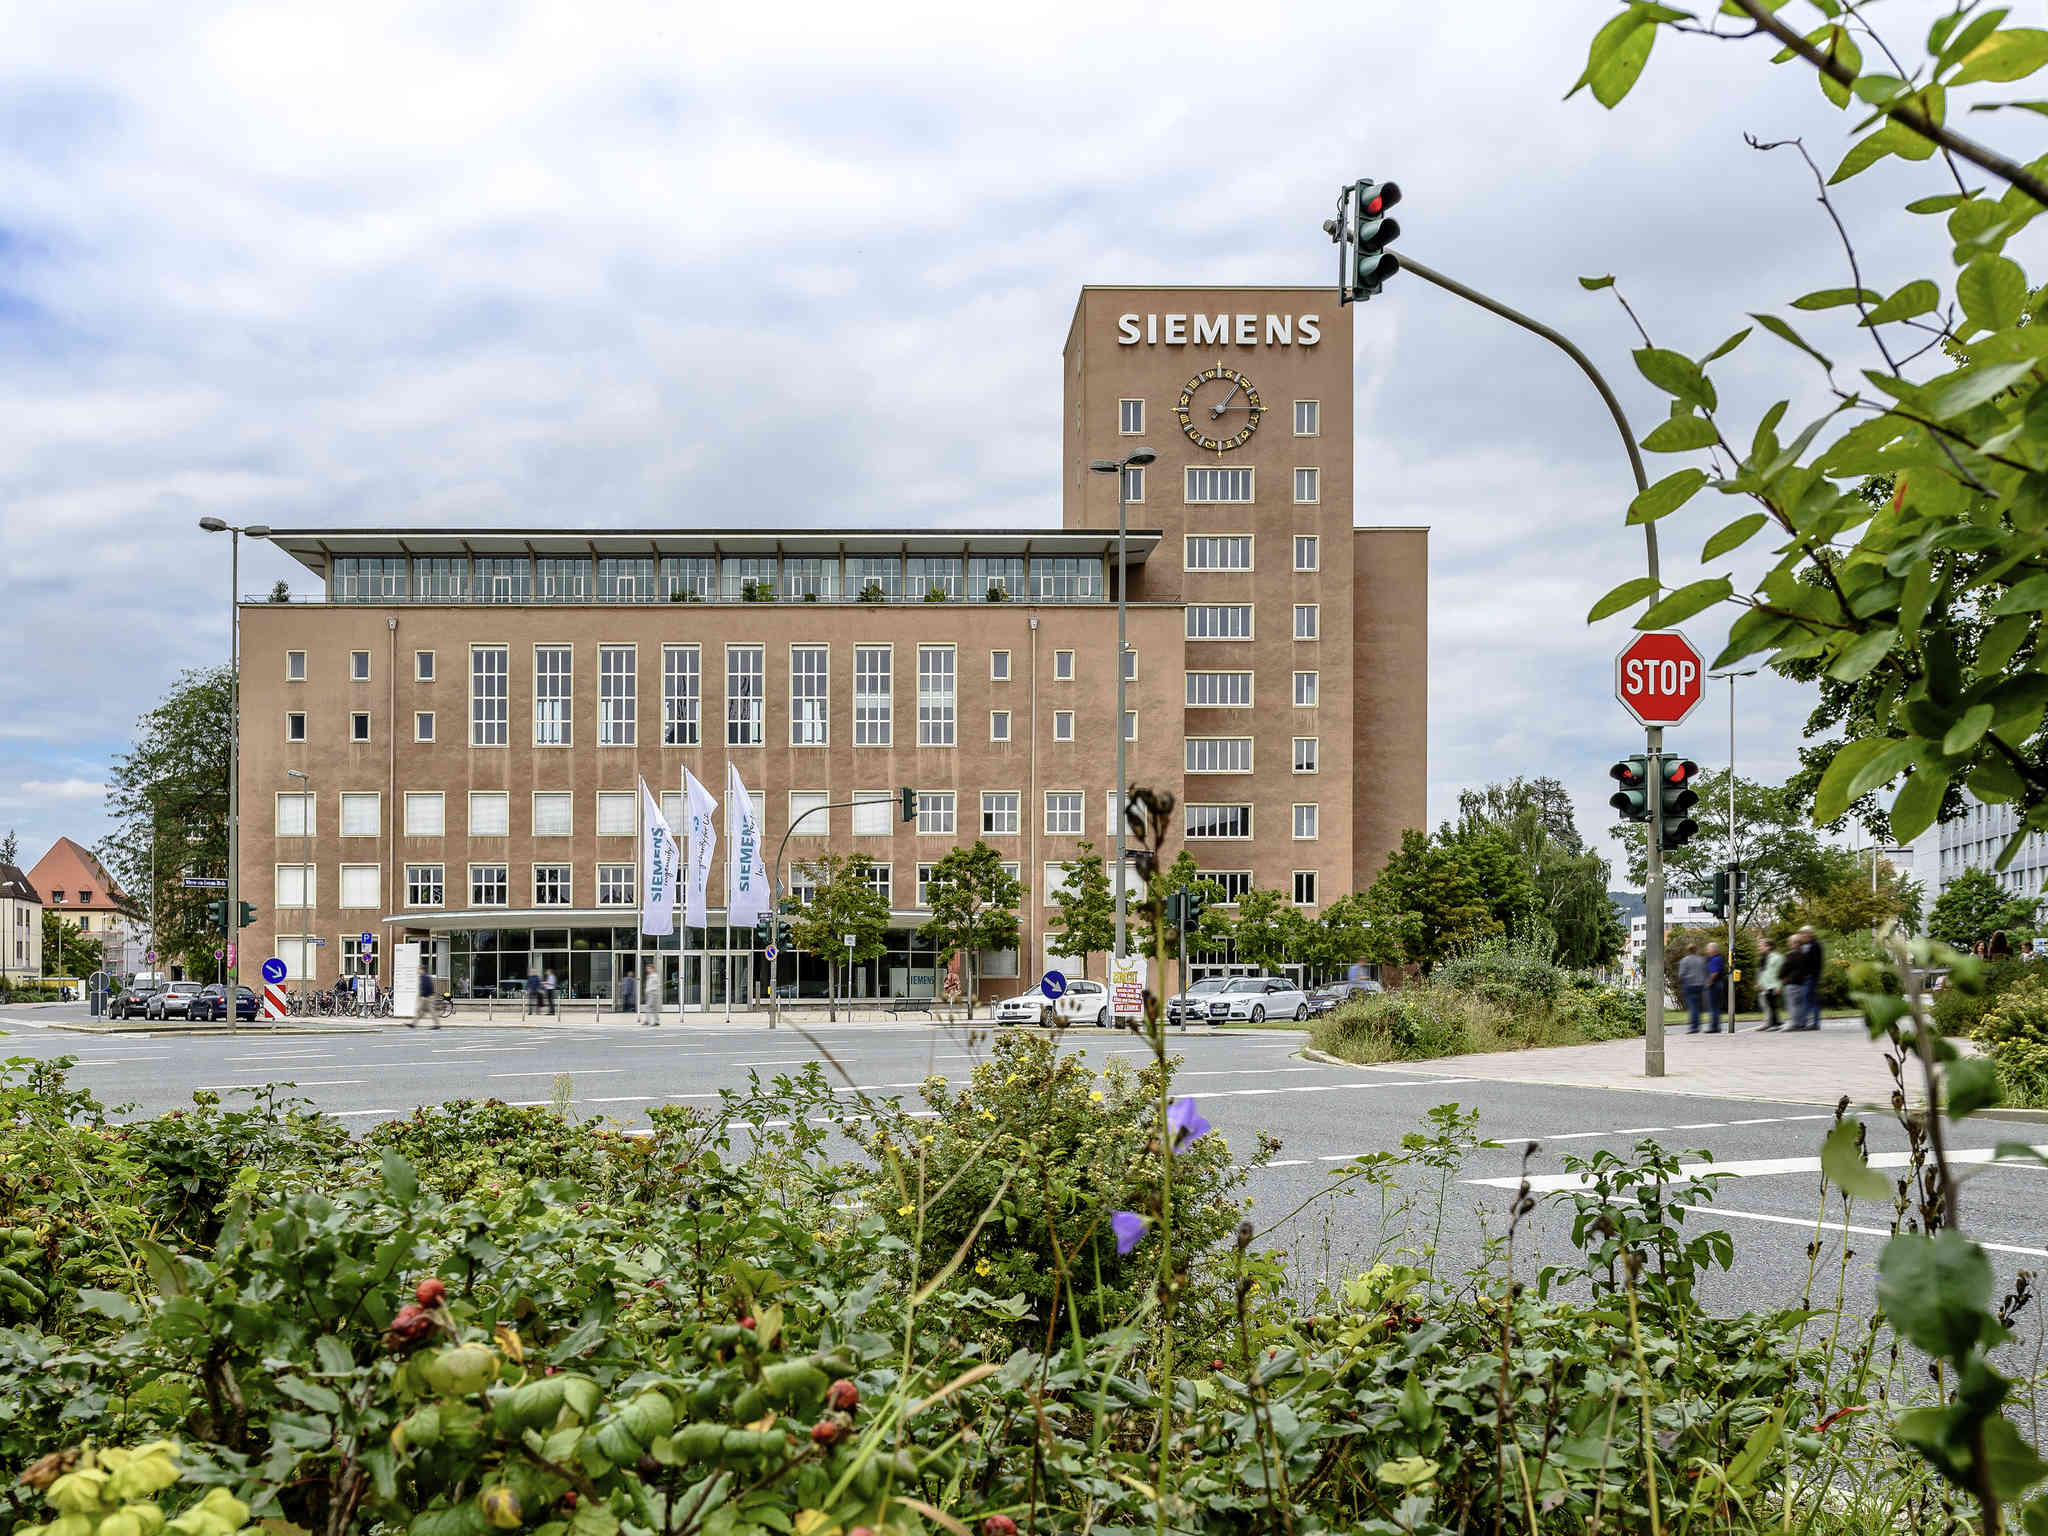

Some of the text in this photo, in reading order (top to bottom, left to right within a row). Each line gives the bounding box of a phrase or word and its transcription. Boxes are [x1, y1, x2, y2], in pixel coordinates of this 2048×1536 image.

[1118, 313, 1321, 346] SIEMENS
[1626, 658, 1696, 696] STOP
[651, 827, 664, 902] SIEMENS
